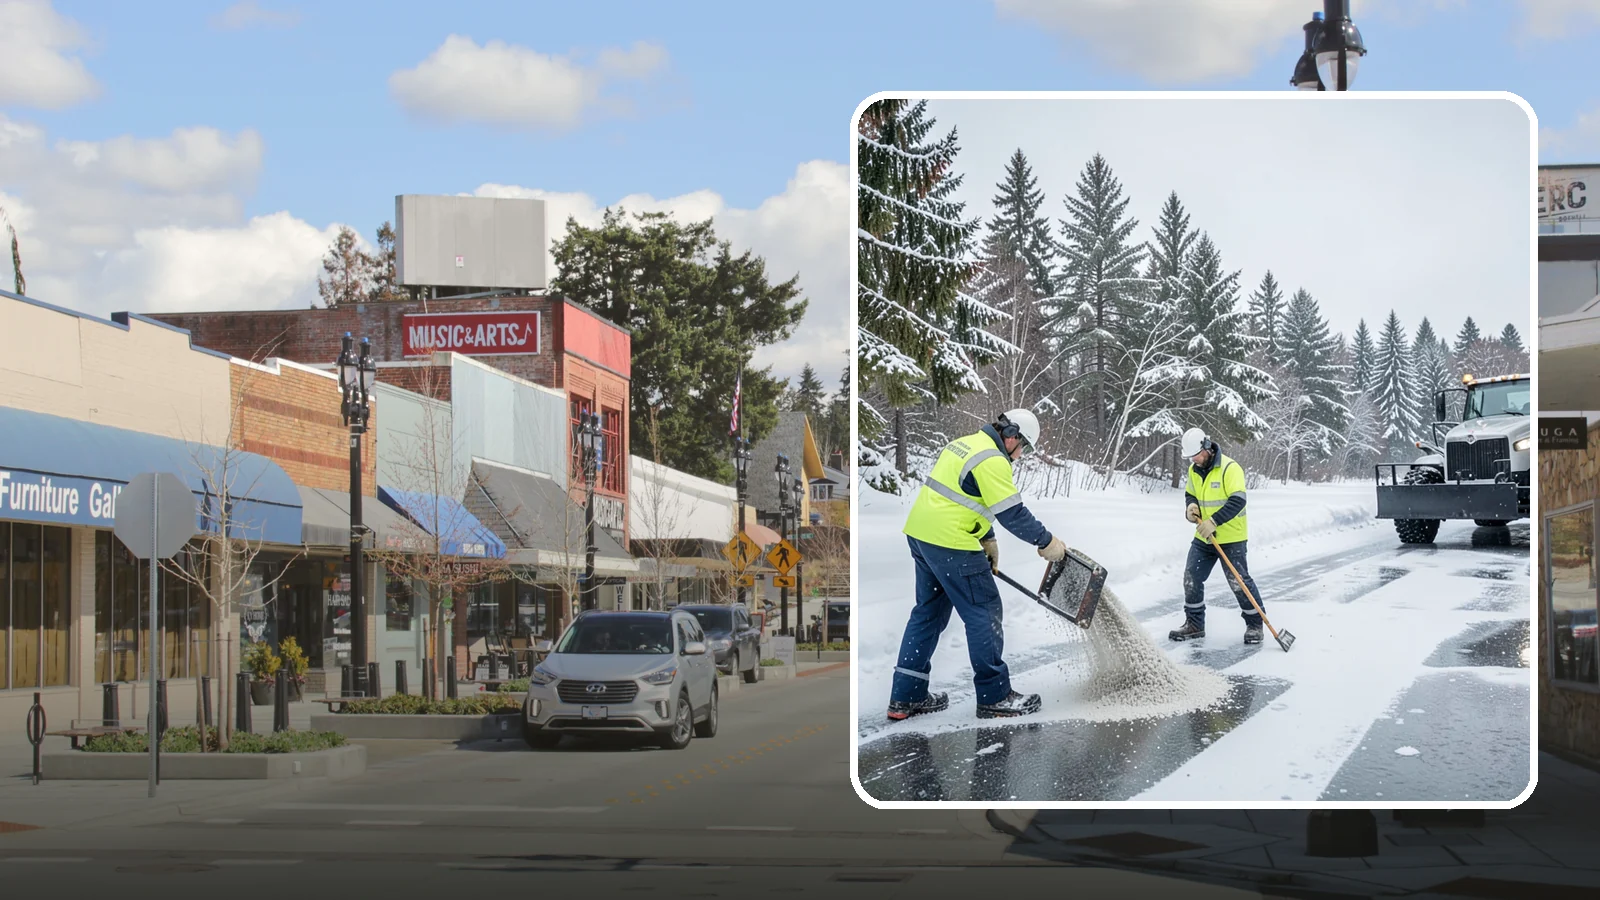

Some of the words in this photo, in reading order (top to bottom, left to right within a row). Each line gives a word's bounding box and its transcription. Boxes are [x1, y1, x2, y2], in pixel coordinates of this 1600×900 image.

[0, 471, 79, 515] Furniture
[89, 482, 122, 519] Gal
[453, 563, 480, 574] SUSHI
